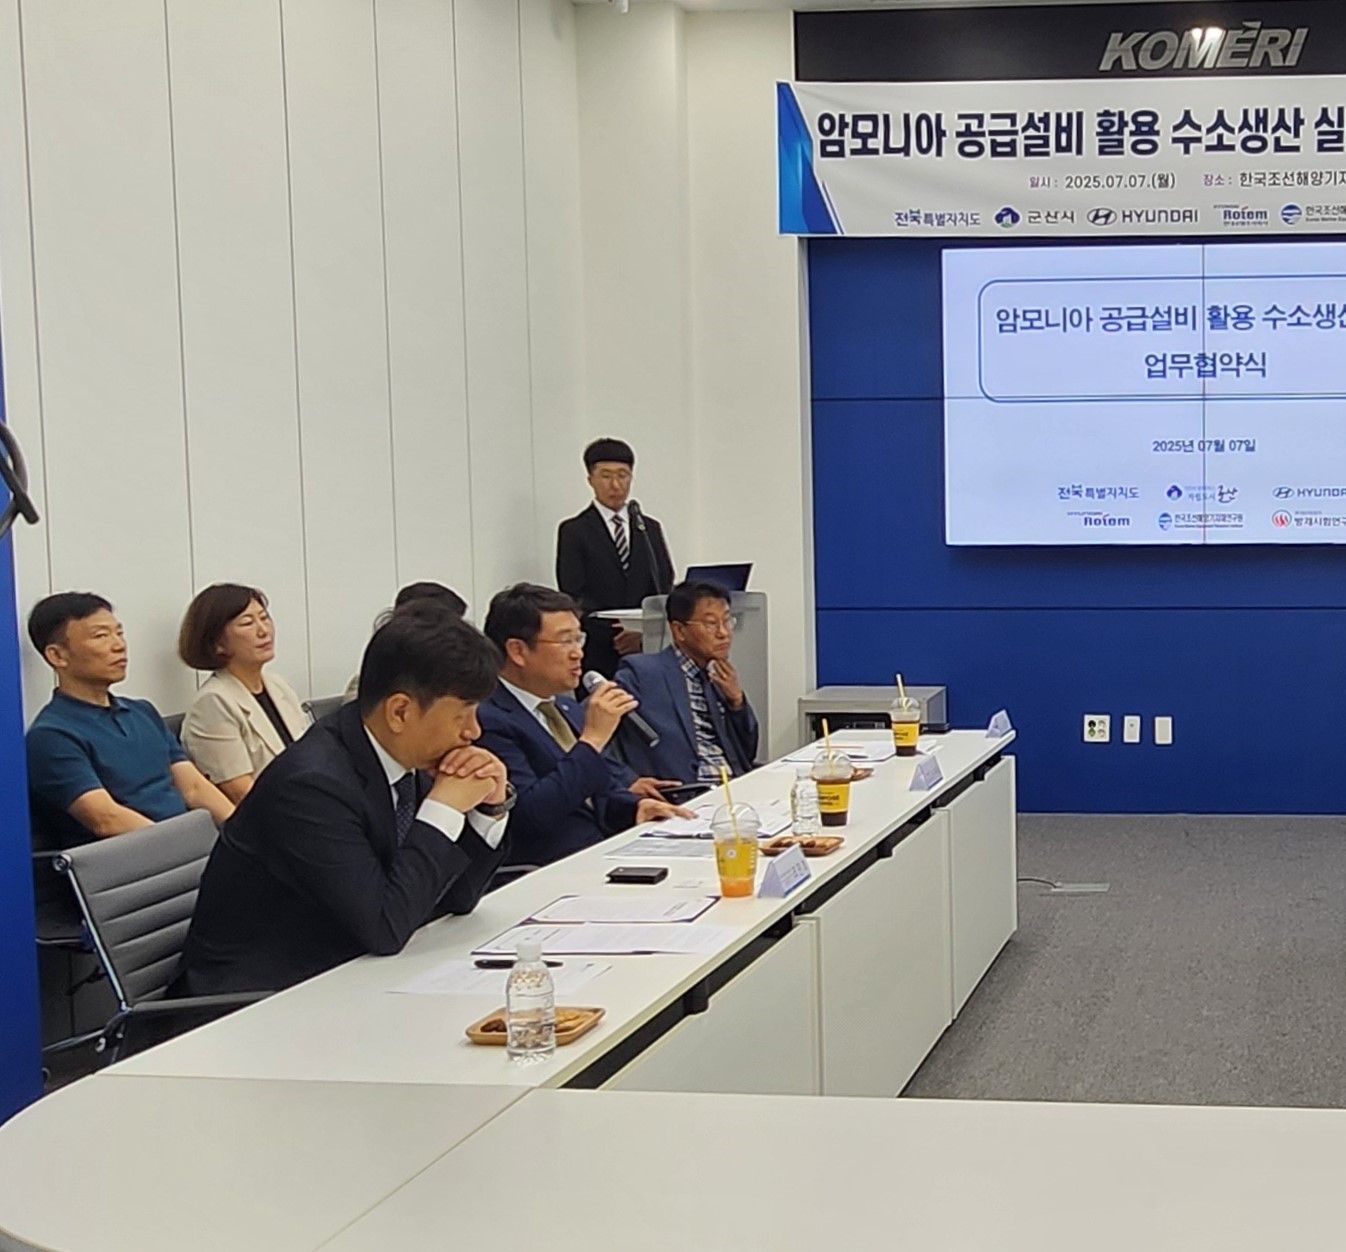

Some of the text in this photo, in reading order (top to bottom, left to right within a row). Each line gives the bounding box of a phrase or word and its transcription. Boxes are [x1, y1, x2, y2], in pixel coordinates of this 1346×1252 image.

[817, 111, 947, 158] 암모니아
[955, 111, 1084, 158] 공급설비
[1095, 110, 1160, 156] 활용
[1171, 107, 1305, 156] 수소생산
[1065, 173, 1176, 190] 2025.07.07.(월)
[1028, 210, 1075, 224] 군산시
[1122, 210, 1199, 223] HYUNDAI
[995, 307, 1094, 333] 암모니아
[1099, 305, 1198, 332] 공급설비
[1206, 304, 1255, 331] 활용
[1144, 351, 1267, 379] 업무협약식
[1152, 439, 1256, 453] 2025년 07월 07일
